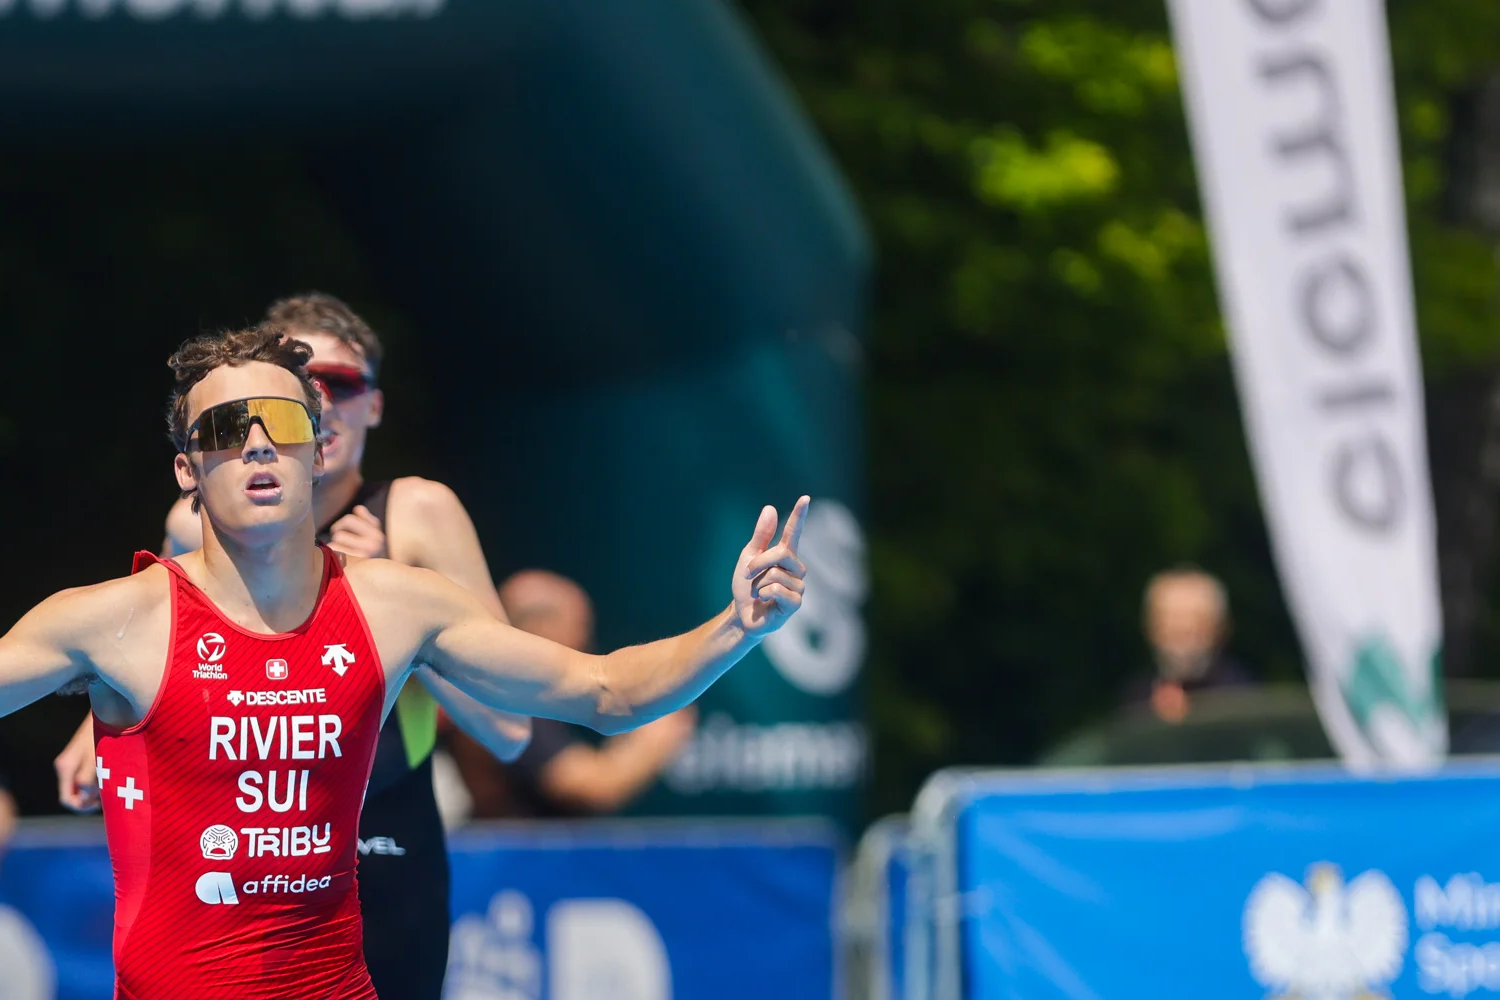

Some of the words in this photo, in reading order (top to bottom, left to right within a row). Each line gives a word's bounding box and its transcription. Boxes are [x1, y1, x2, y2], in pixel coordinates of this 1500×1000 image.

[192, 669, 228, 680] Triathlon
[198, 662, 223, 672] World
[246, 688, 327, 706] DESCENTE
[208, 714, 343, 761] RIVIER
[235, 769, 310, 813] SUI
[242, 874, 332, 894] affidea
